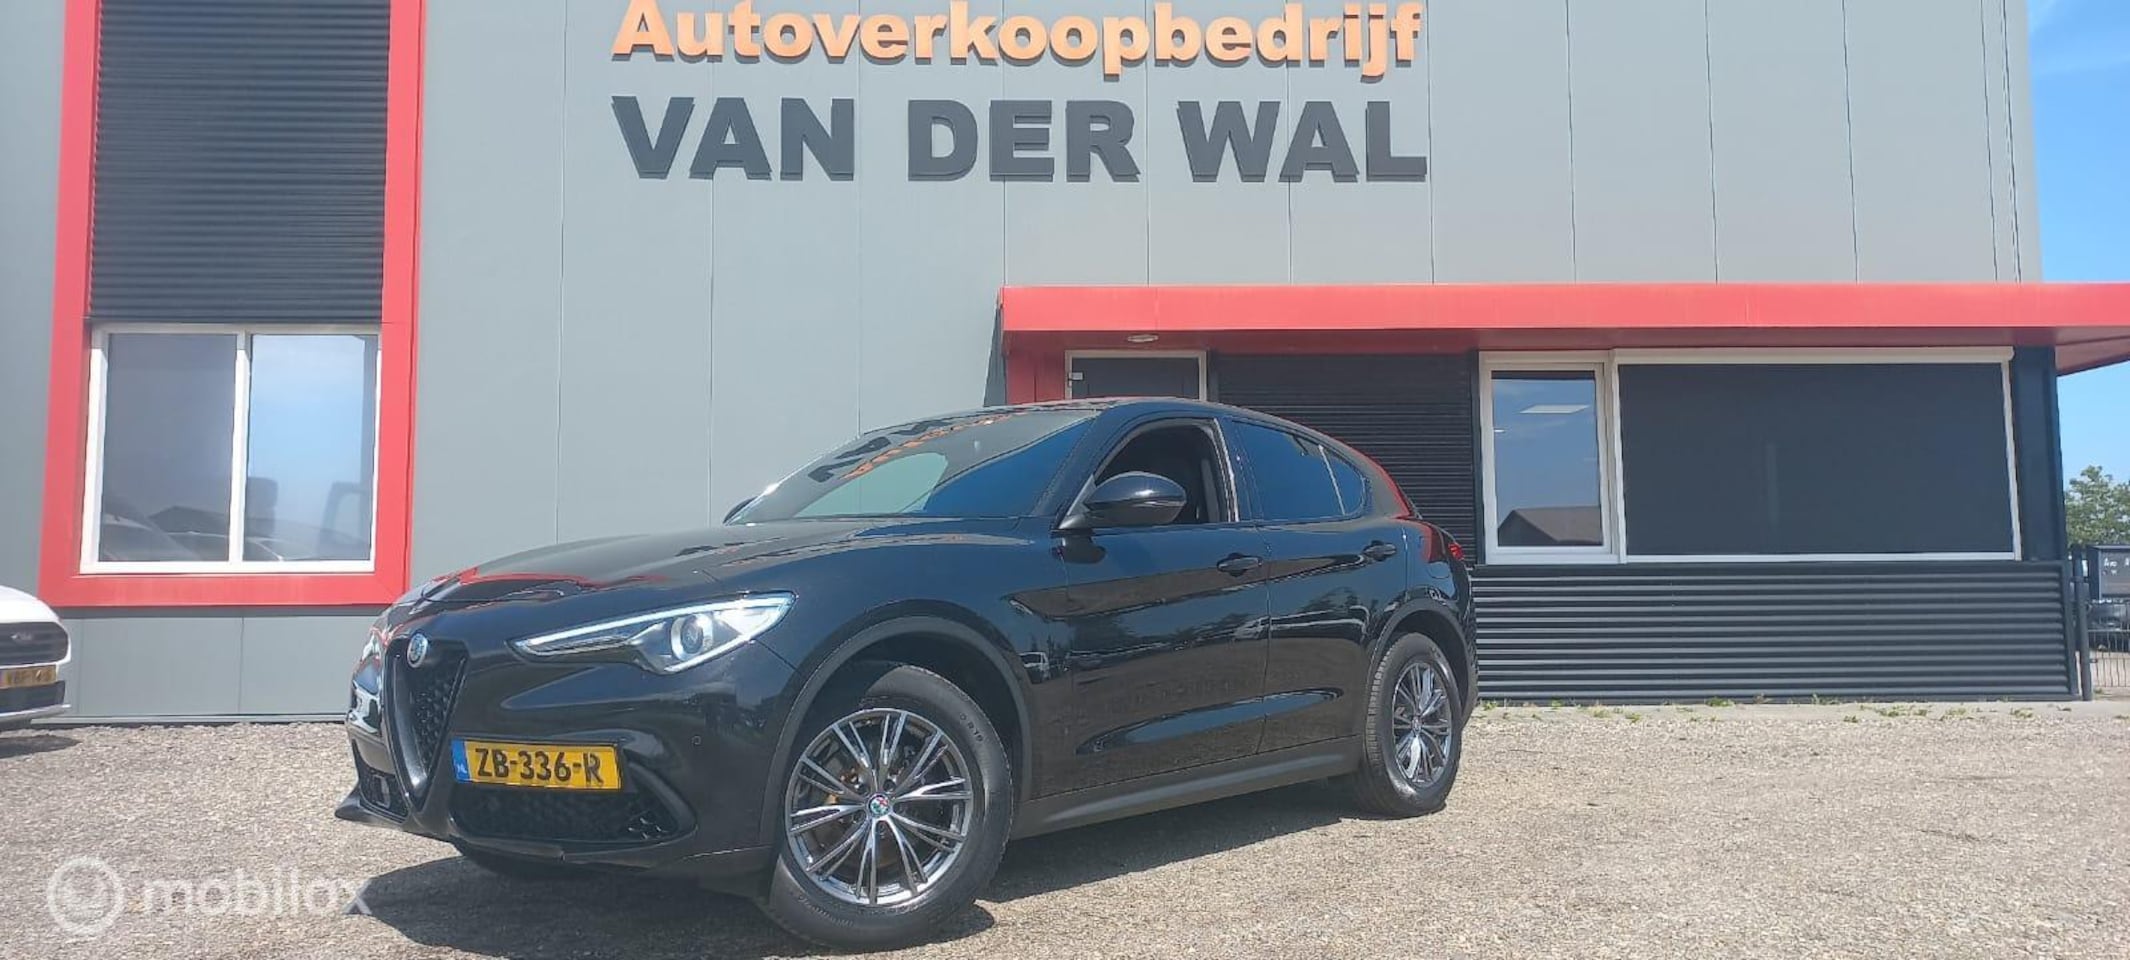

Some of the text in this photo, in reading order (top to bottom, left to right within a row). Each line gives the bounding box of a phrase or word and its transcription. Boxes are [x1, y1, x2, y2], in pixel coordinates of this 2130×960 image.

[611, 0, 1424, 82] Autoverkoopbedrijf
[611, 96, 1428, 182] VAN DER WAL
[474, 747, 604, 786] ZB-336-R
